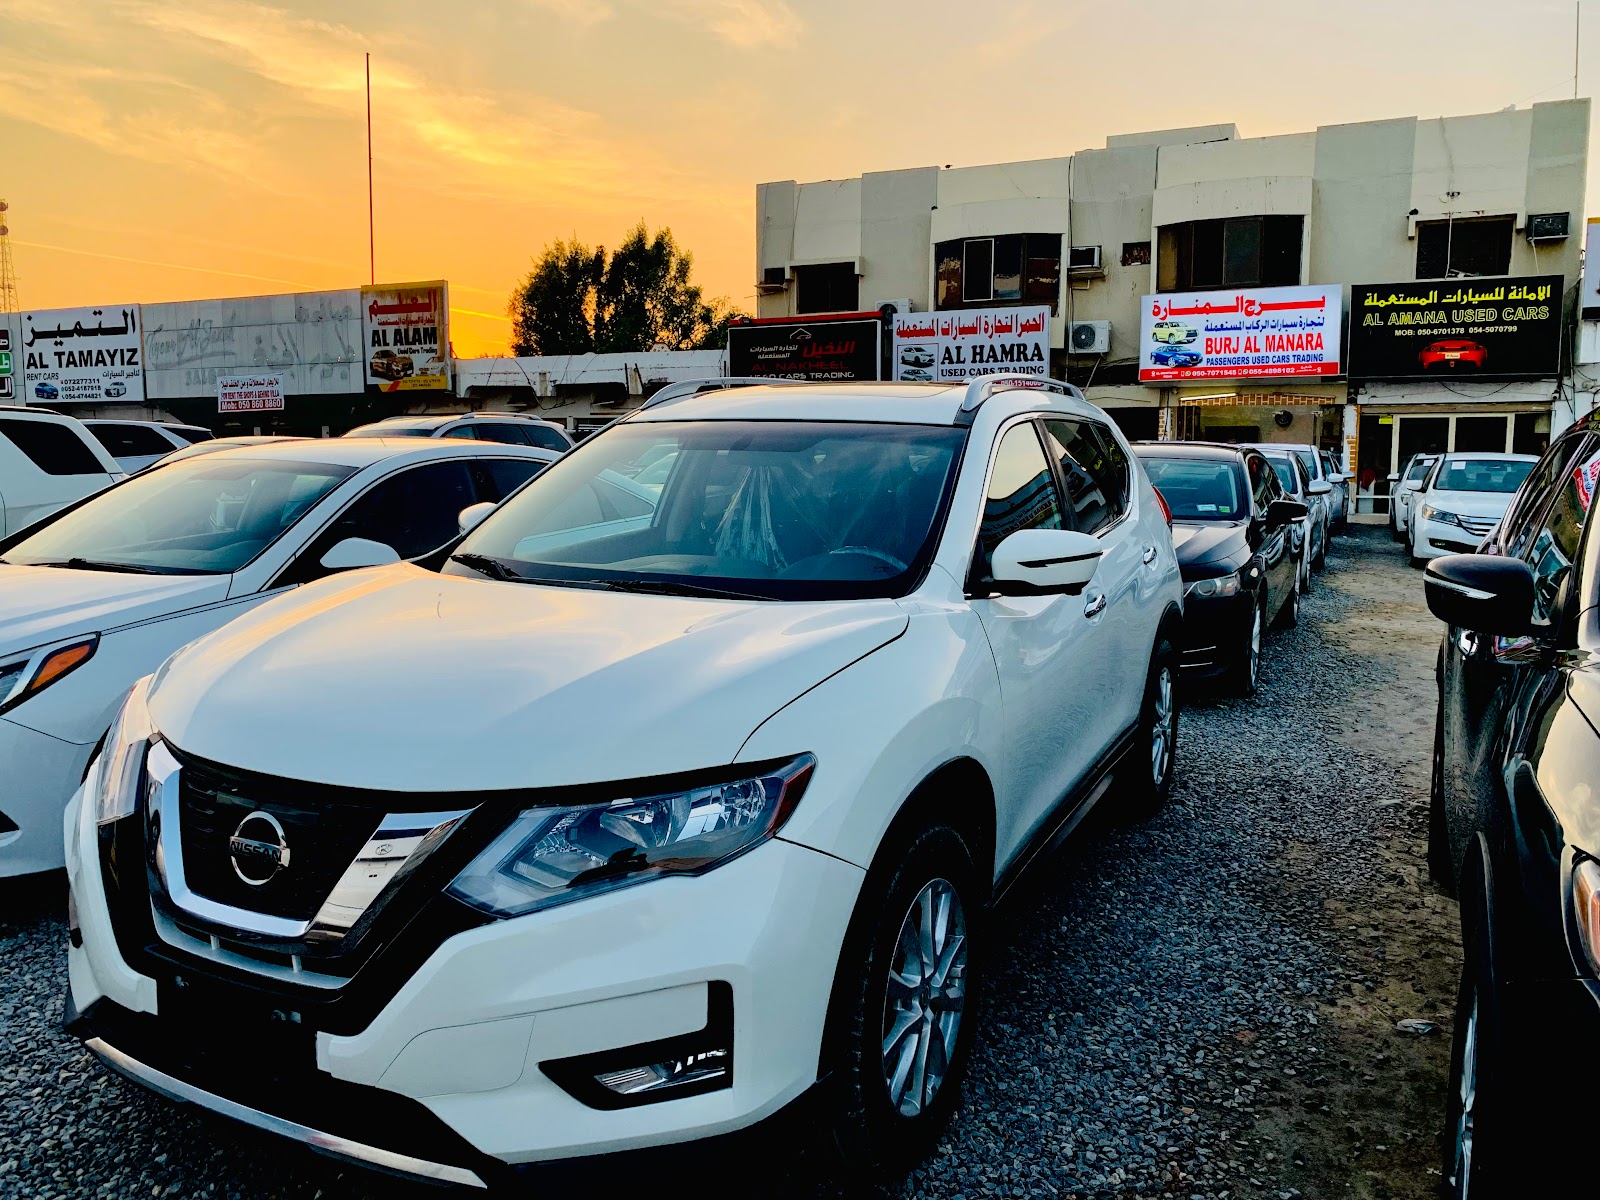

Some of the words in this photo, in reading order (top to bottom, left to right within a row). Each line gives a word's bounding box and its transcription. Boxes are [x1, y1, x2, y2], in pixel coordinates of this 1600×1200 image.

[1364, 290, 1438, 307] المستعملة
[1441, 287, 1504, 305] للسيارات
[1508, 284, 1551, 301] الامانة
[1152, 295, 1243, 321] المنارة
[1244, 295, 1326, 318] برج
[1015, 312, 1045, 337] الحمرا
[1299, 315, 1325, 331] لتجارة
[1363, 312, 1384, 326] AL
[1387, 311, 1448, 325] AMANA
[1452, 308, 1498, 323] USED
[1502, 306, 1549, 321] CARS
[25, 308, 136, 347] التميز
[896, 317, 939, 339] المستعملة
[941, 315, 982, 340] السيارات
[984, 314, 1013, 339] لتجارة
[1204, 319, 1244, 332] المستعملة
[1245, 319, 1269, 333] الركاب
[1270, 319, 1298, 332] سيارات
[371, 329, 389, 347] AL
[393, 327, 437, 346] ALAM
[1205, 336, 1240, 355] BURJ
[1243, 335, 1260, 353] AL
[1265, 333, 1324, 352] MANARA
[26, 352, 49, 369] AL
[54, 348, 139, 368] TAMAYIZ
[420, 346, 437, 355] Trading
[803, 340, 856, 359] النخيل
[940, 345, 966, 365] AL
[971, 342, 1044, 364] HAMRA
[751, 362, 770, 371] AL
[776, 360, 849, 371] NAKHEEL
[1206, 356, 1250, 366] PASSENGERS
[1252, 355, 1270, 364] USED
[1272, 355, 1290, 363] CARS
[1292, 353, 1324, 362] TRADING
[27, 373, 42, 381] RENT
[43, 372, 59, 381] CARS
[809, 371, 855, 379] TRADING
[941, 368, 966, 377] USED
[969, 367, 995, 377] CARS
[998, 366, 1044, 375] TRADING
[221, 401, 237, 410] Mob:
[238, 400, 250, 409] 050
[251, 400, 264, 408] 860
[264, 399, 281, 408] 8860
[230, 841, 281, 863] NISSAN
